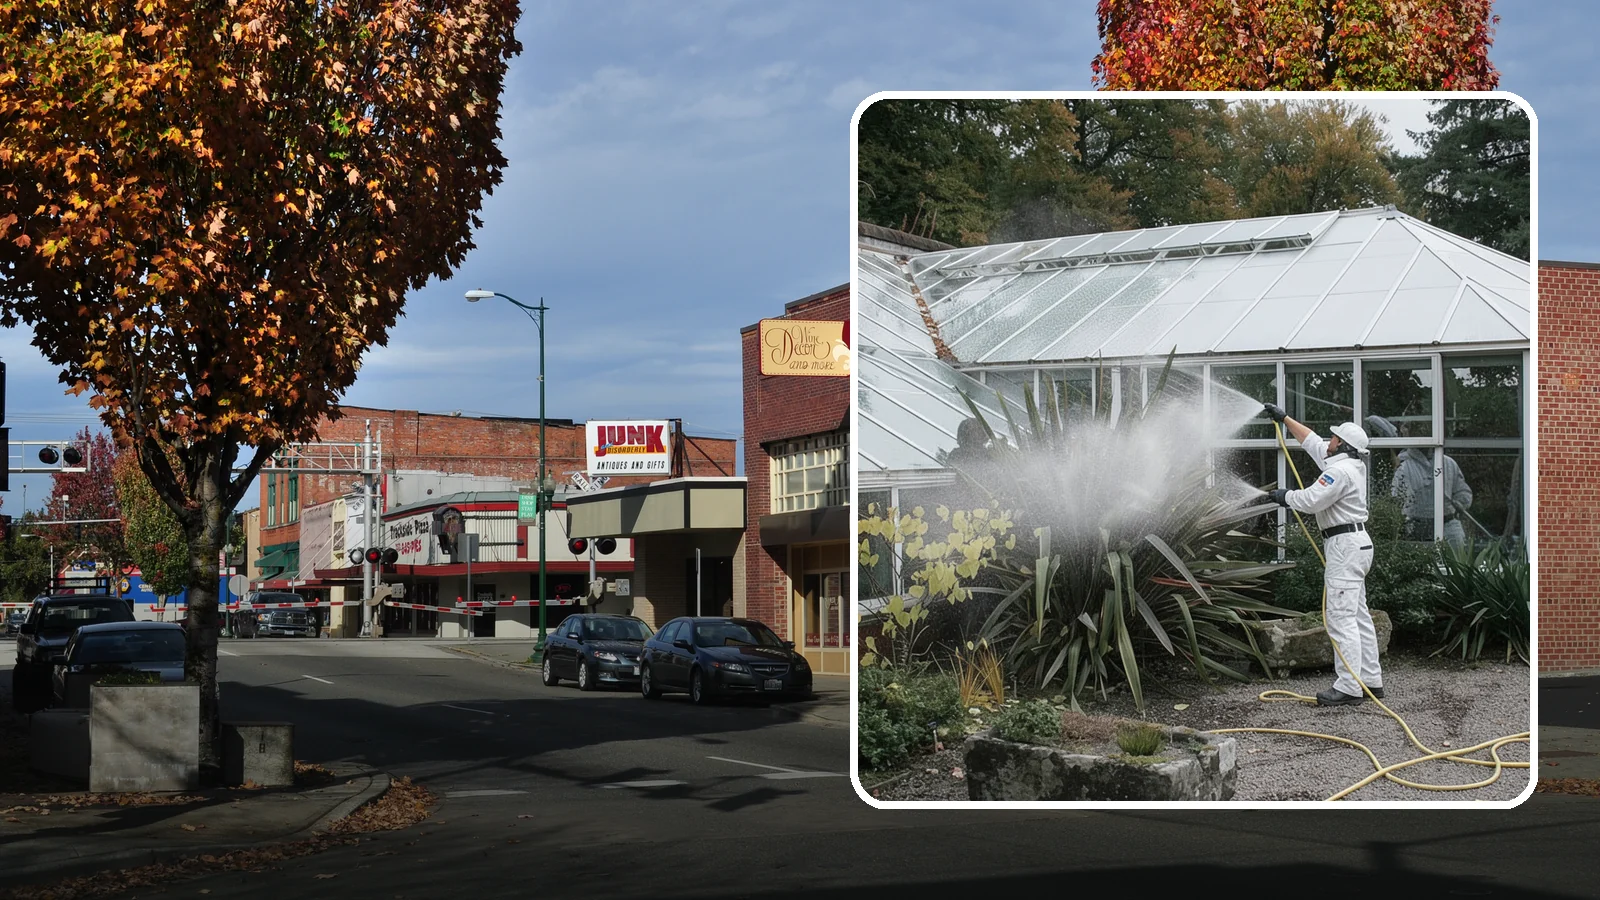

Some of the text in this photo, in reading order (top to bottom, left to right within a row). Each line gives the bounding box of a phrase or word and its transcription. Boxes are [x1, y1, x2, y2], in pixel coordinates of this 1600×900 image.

[595, 425, 664, 457] JUNK
[607, 446, 646, 454] DISORDERLY
[597, 460, 665, 470] ANTIQUES AND GIFTS
[390, 520, 429, 539] Trackside Pizza
